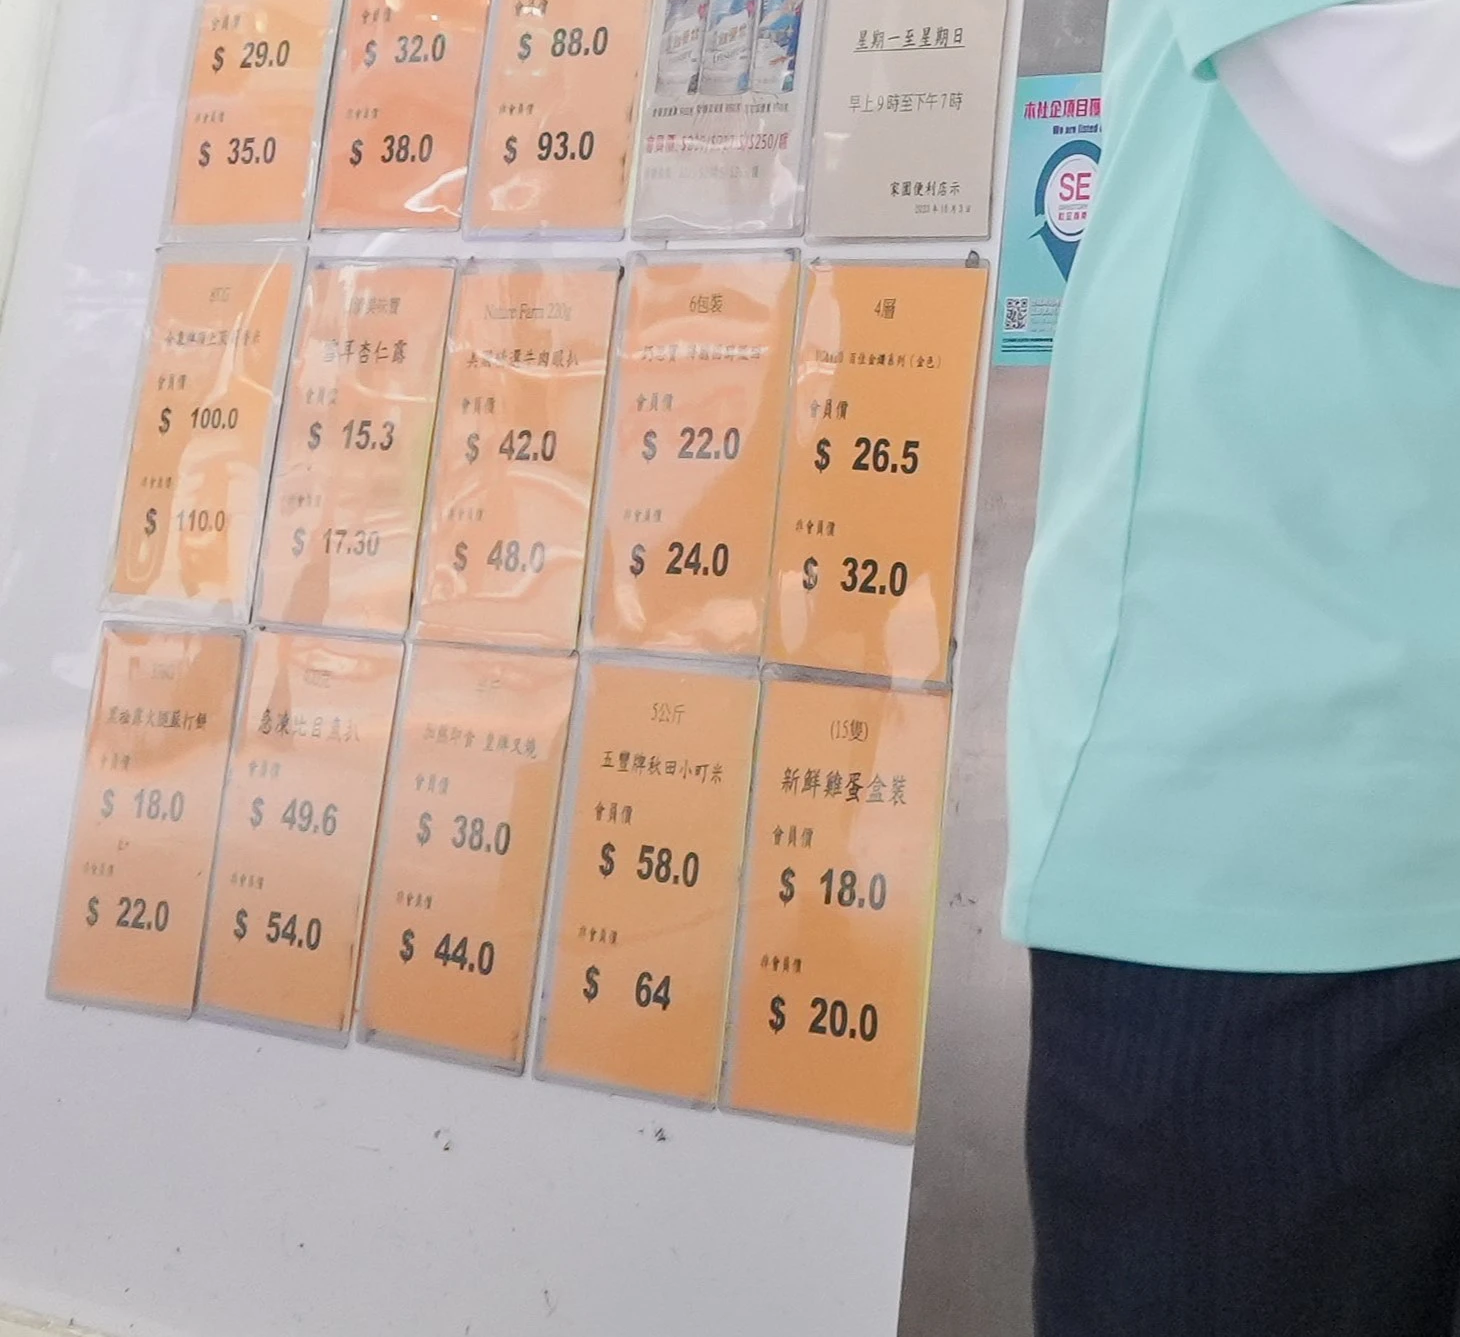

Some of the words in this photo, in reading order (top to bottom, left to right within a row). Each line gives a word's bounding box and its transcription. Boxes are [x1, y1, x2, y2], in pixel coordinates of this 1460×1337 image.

[364, 40, 377, 67] $
[394, 33, 446, 64] 32.0
[518, 32, 532, 61] $
[551, 26, 608, 57] 88.0
[857, 27, 965, 49] 星期一至星期日
[212, 46, 225, 72] $
[240, 39, 290, 69] 29.0
[848, 92, 963, 113] 早上9時至下午7時
[198, 141, 211, 167] $
[227, 137, 276, 165] 35.0
[350, 139, 363, 167] $
[381, 133, 433, 163] 38.0
[504, 136, 517, 164] $
[537, 131, 594, 160] 93.0
[1059, 172, 1091, 201] SE
[158, 407, 171, 435] $
[191, 407, 239, 430] 100.0
[307, 422, 322, 449] $
[342, 419, 395, 451] 15.3
[465, 433, 479, 464] $
[499, 429, 557, 462] 42.0
[642, 429, 657, 462] $
[677, 426, 741, 460] 22.0
[814, 437, 830, 473] $
[852, 437, 919, 475] 26.5
[144, 508, 157, 536] $
[175, 509, 225, 532] 110.0
[291, 528, 305, 557] $
[453, 541, 468, 573] $
[487, 539, 545, 573] 48.0
[629, 544, 645, 577] $
[665, 541, 730, 577] 24.0
[803, 556, 818, 591] $
[840, 557, 908, 596] 32.0
[781, 767, 908, 806] 新鮮雞蛋盒裝
[101, 788, 114, 818] $
[134, 788, 185, 822] 18.0
[250, 797, 264, 830] $
[280, 797, 337, 836] 49.6
[594, 800, 633, 826] 會員價
[416, 812, 432, 845] $
[452, 814, 511, 856] 38.0
[773, 825, 814, 850] 會員價
[599, 842, 615, 879] $
[636, 845, 699, 888] 58.0
[779, 866, 796, 905] $
[820, 868, 887, 912] 18.0
[86, 896, 99, 927] $
[116, 897, 170, 931] 22.0
[233, 908, 248, 943] $
[266, 911, 322, 950] 54.0
[400, 928, 415, 963] $
[434, 933, 495, 976] 44.0
[583, 965, 599, 1003] $
[635, 971, 671, 1011] 64
[769, 994, 785, 1034] $
[809, 996, 878, 1042] 20.0
